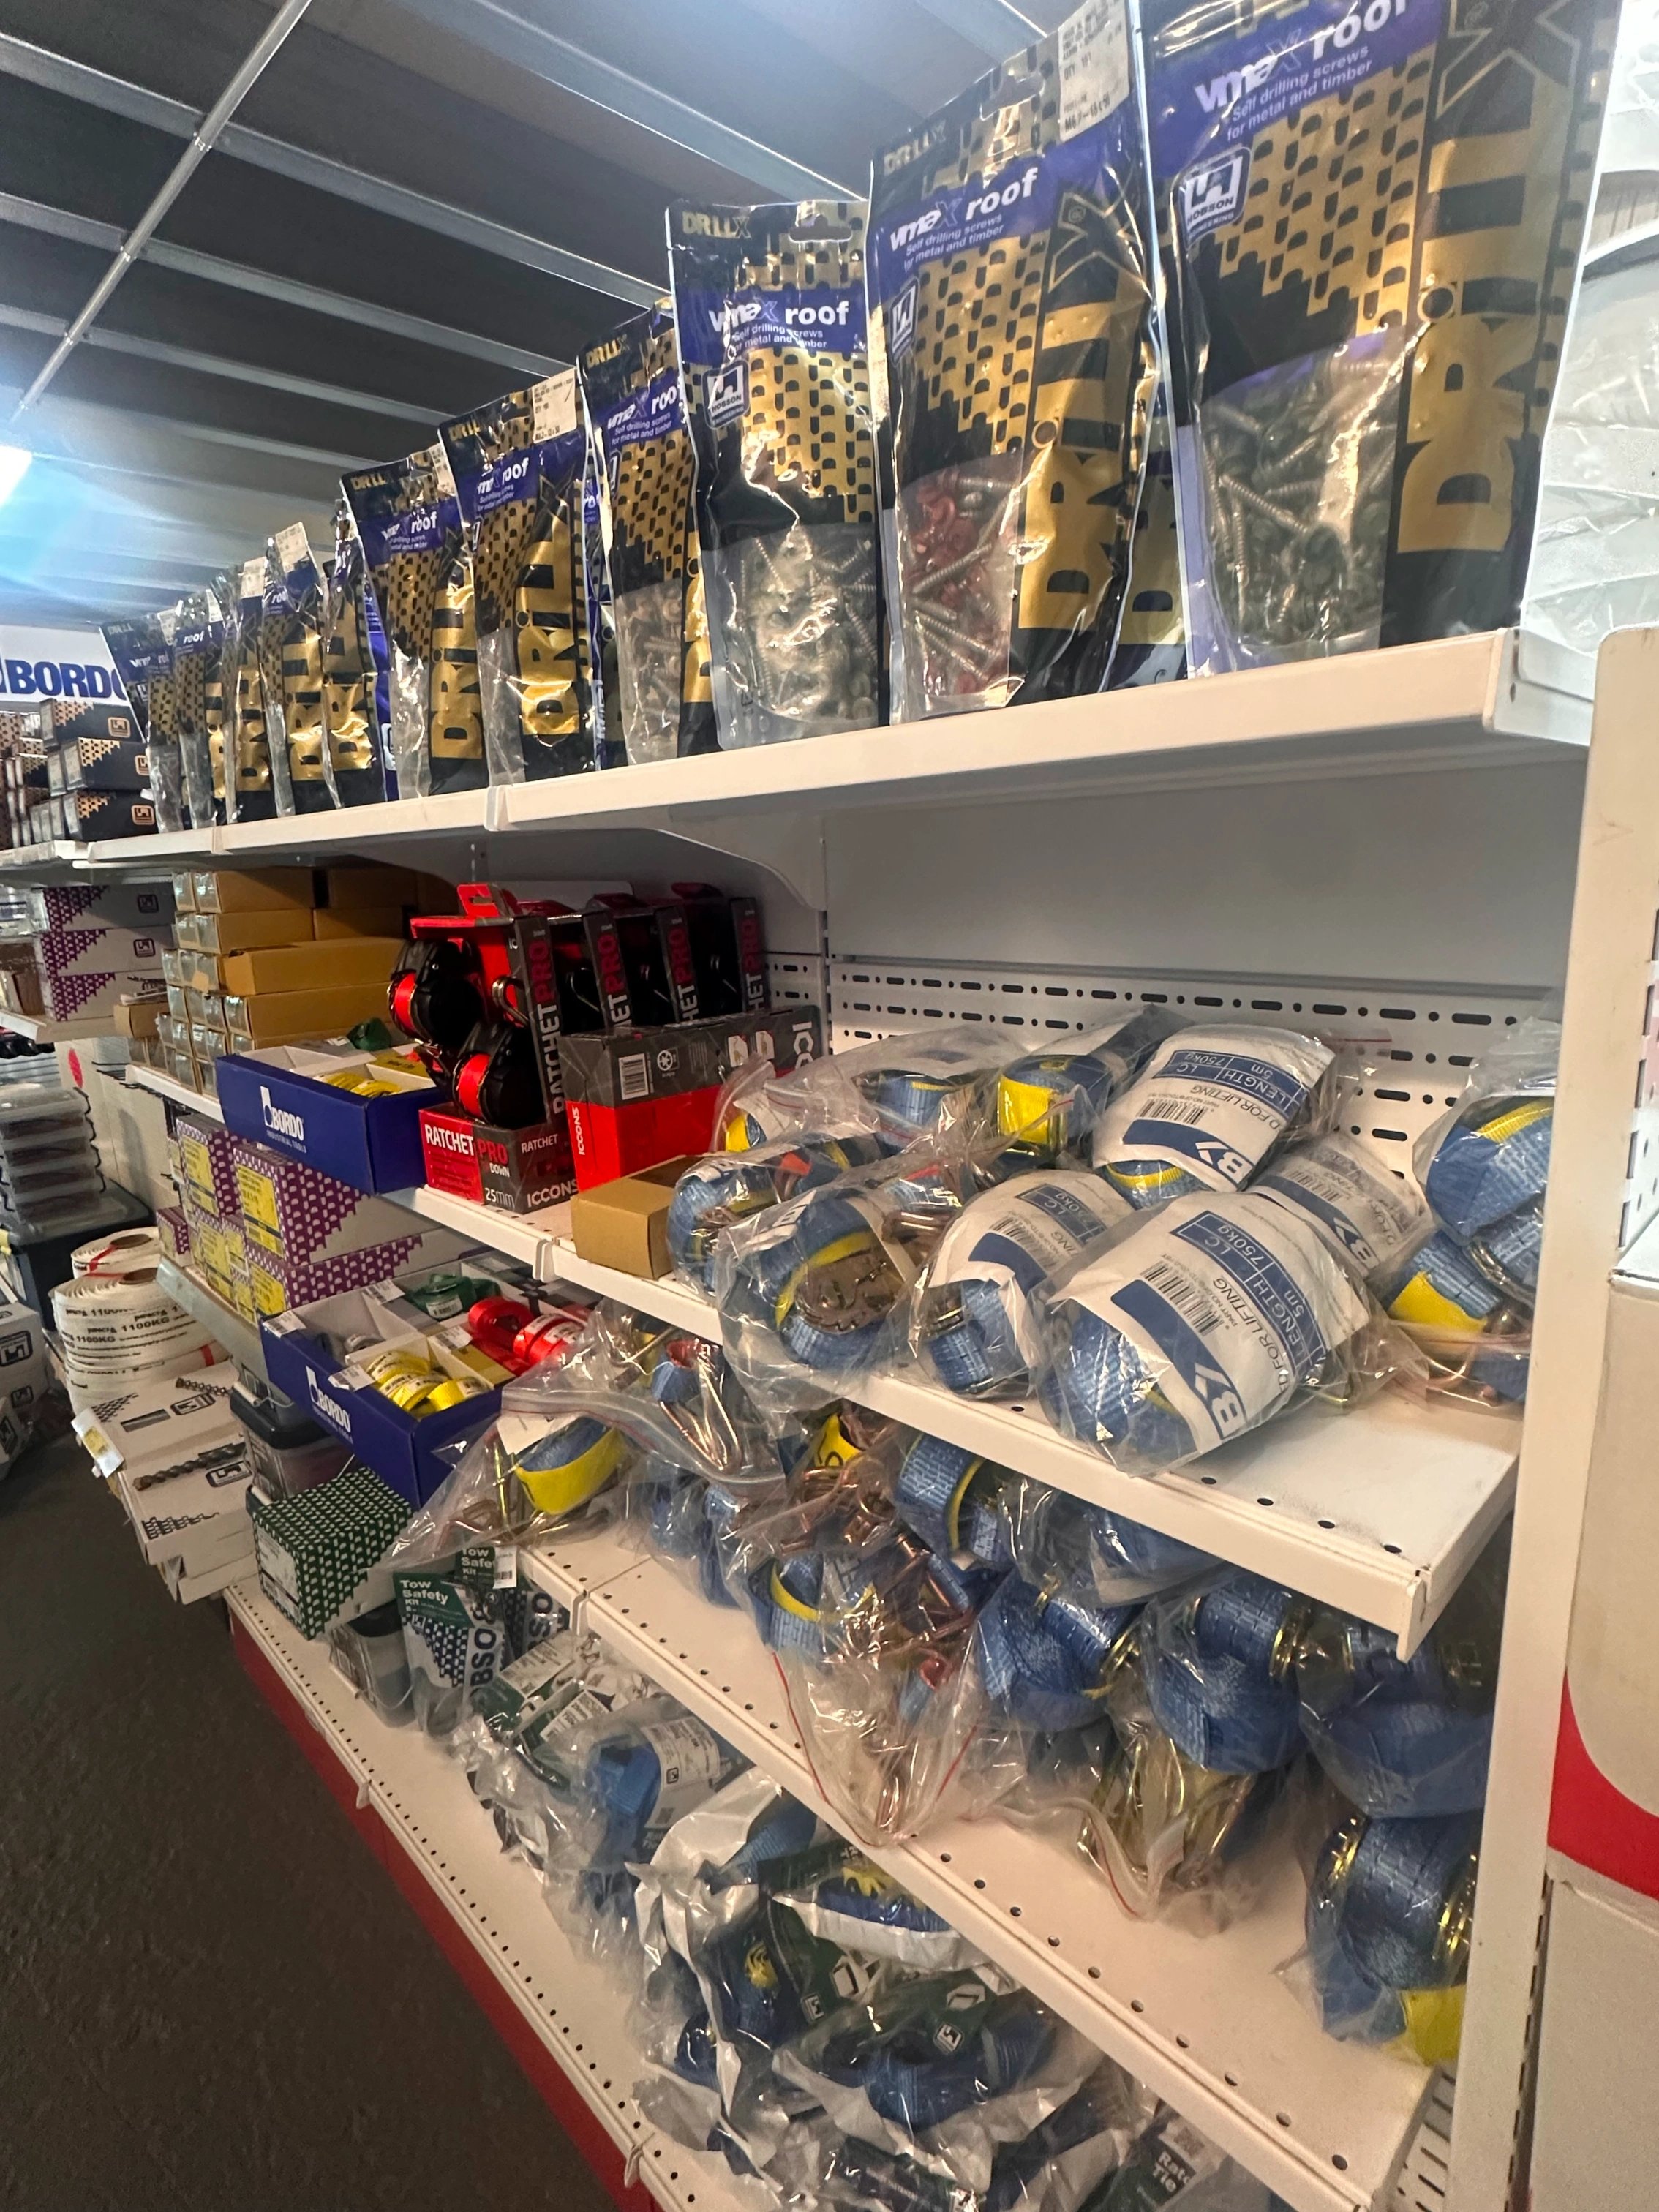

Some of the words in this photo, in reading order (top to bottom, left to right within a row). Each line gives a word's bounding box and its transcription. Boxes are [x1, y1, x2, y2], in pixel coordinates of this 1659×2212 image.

[1232, 99, 1256, 122] Self
[1260, 73, 1309, 105] drilling
[1313, 45, 1369, 77] screws
[1227, 124, 1245, 141] for
[1248, 103, 1285, 131] metal
[1290, 87, 1316, 108] and
[1322, 60, 1372, 89] timber
[966, 167, 1039, 221] roof
[916, 246, 944, 266] metal
[947, 238, 966, 252] and
[969, 225, 1004, 247] timber
[925, 226, 962, 248] drilling
[964, 214, 1002, 234] screws
[785, 301, 849, 326] roof
[745, 336, 772, 348] metal
[773, 333, 792, 343] and
[752, 324, 786, 334] drilling
[620, 430, 639, 442] metal
[640, 428, 655, 439] and
[502, 458, 529, 484] roof
[411, 512, 437, 534] roof
[597, 933, 625, 993] PRO
[669, 927, 693, 984] PRO
[529, 940, 556, 1004] PRO
[1184, 1052, 1227, 1066] 750kg
[1251, 1064, 1273, 1080] 5m
[1176, 1064, 1197, 1075] LC
[1222, 1069, 1286, 1105] LENGTH
[1190, 1085, 1241, 1106] LIFTING
[271, 1107, 304, 1141] BORDO
[1241, 1102, 1269, 1122] FOR
[424, 1124, 475, 1156] RATCHET
[477, 1138, 508, 1165] PRO
[521, 1134, 558, 1154] RATCHET
[572, 1106, 586, 1156] ICCONS
[489, 1163, 511, 1178] DOWN
[485, 1187, 515, 1208] 25mm
[527, 1179, 579, 1208] ICCONS
[1044, 1198, 1069, 1219] LC
[1217, 1222, 1266, 1271] 750kg
[1204, 1233, 1233, 1259] LC
[1254, 1279, 1309, 1358] LENGTH
[1213, 1276, 1263, 1336] LIFTING
[1284, 1290, 1309, 1319] 5m
[121, 1317, 170, 1332] 1100KG
[1259, 1334, 1285, 1369] FOR
[317, 1388, 351, 1433] BORDO
[461, 1548, 489, 1557] Tow
[400, 1580, 432, 1589] Tow
[402, 1589, 448, 1606] Safety
